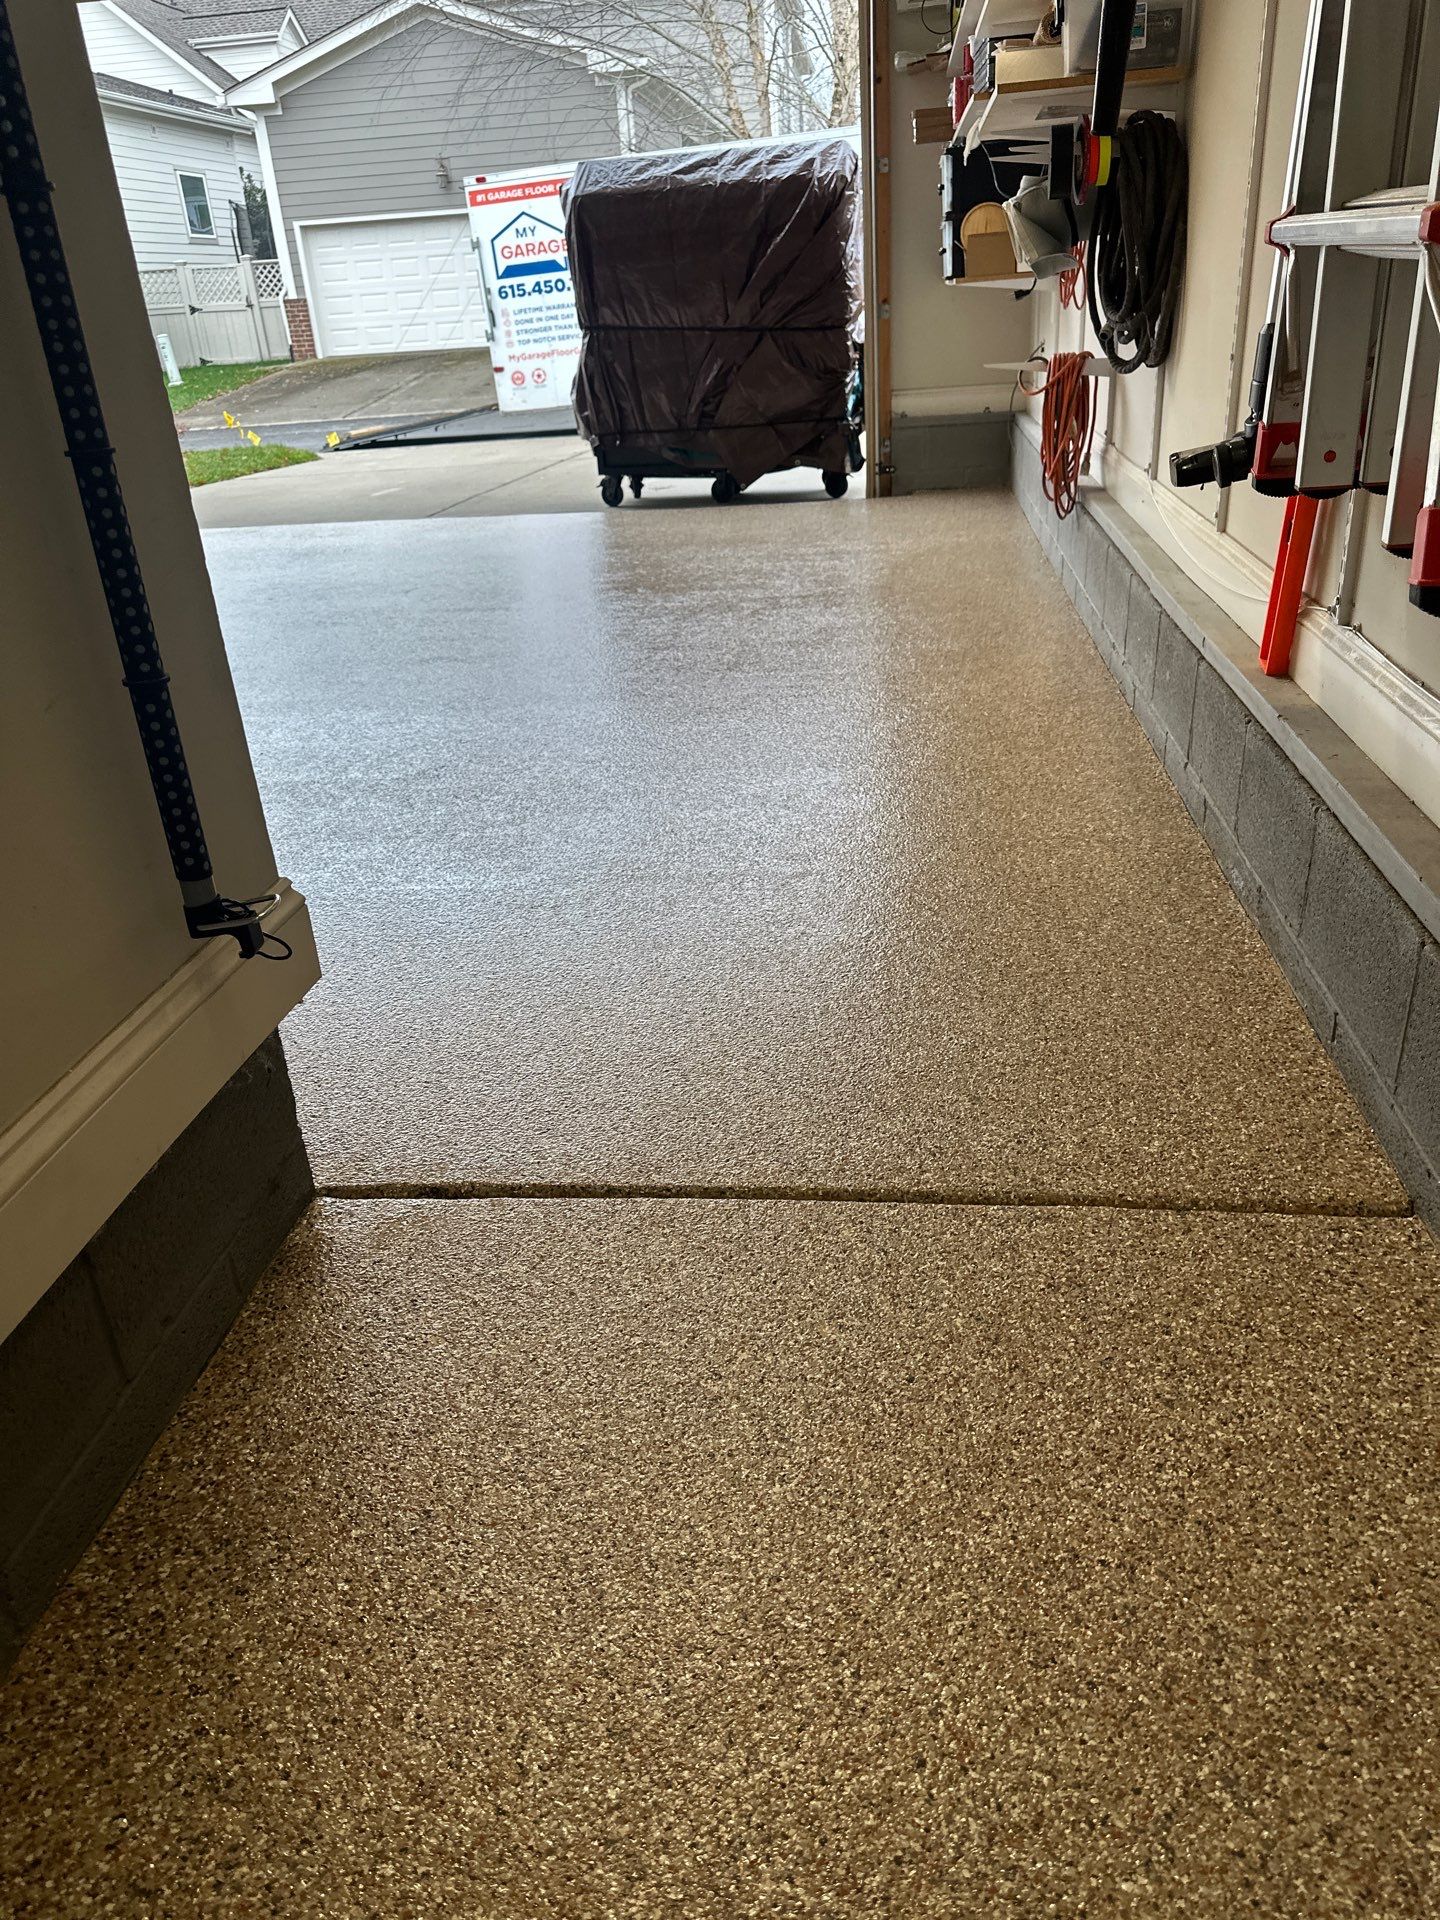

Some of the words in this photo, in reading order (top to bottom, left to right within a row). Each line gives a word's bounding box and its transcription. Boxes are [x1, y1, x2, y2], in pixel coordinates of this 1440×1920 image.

[476, 193, 486, 203] #1
[487, 188, 524, 201] GARAGE
[524, 184, 555, 196] FLOOR
[515, 226, 536, 238] MY
[501, 238, 568, 259] GARAGE
[498, 278, 572, 299] 615.450.
[513, 305, 544, 315] LIFETIME
[514, 317, 534, 326] DONE
[544, 314, 559, 322] ONE
[516, 325, 553, 336] STRONGER
[554, 323, 573, 331] THAN
[517, 338, 531, 346] TOP
[532, 336, 556, 344] NOTCH
